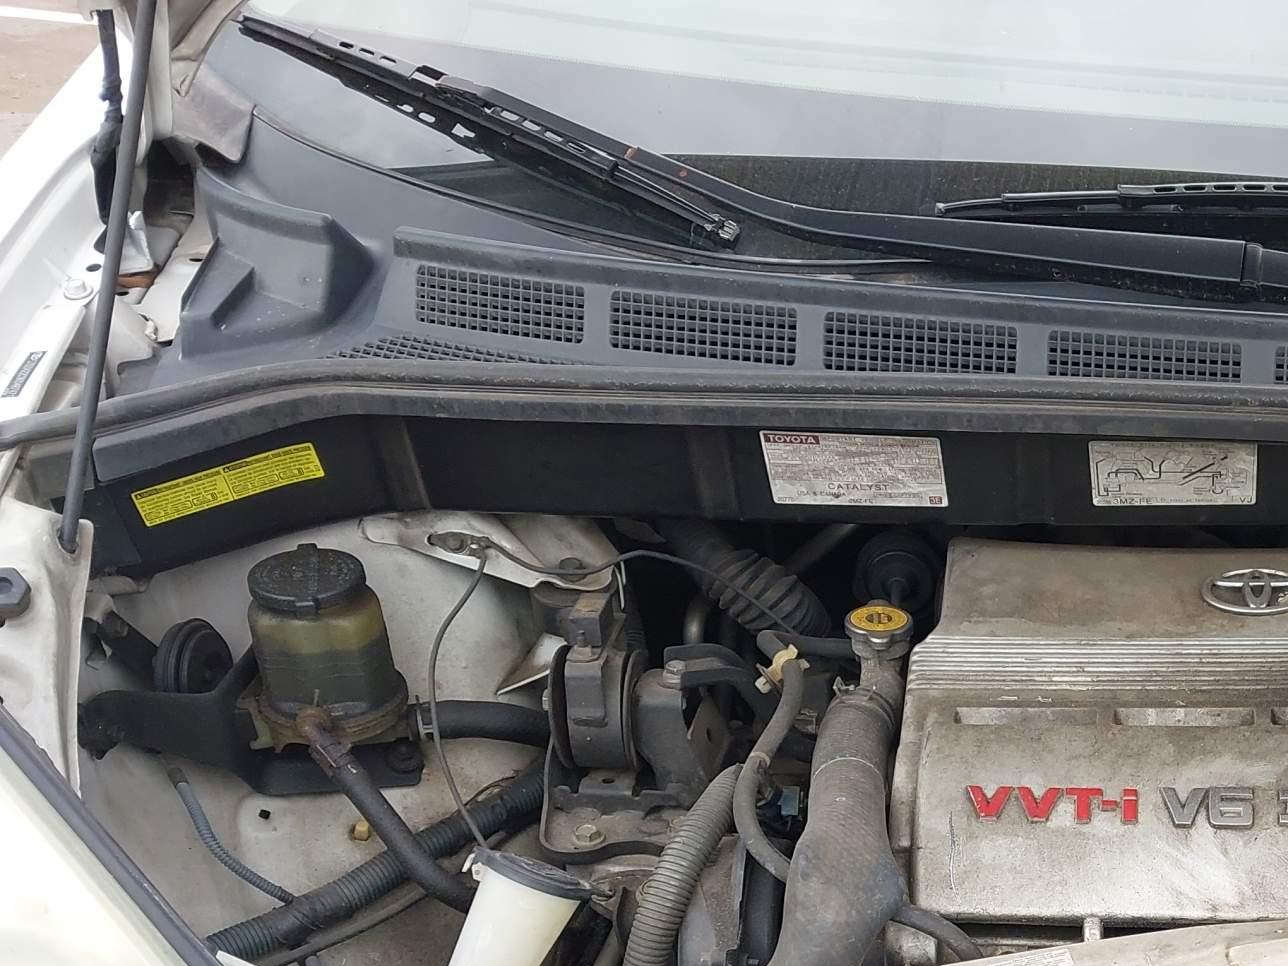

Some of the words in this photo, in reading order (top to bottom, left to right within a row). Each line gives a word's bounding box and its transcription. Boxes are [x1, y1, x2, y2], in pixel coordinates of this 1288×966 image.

[767, 434, 816, 444] TOYOTA
[827, 482, 889, 492] CATALYST
[966, 785, 1141, 824] VVT-i
[1159, 786, 1256, 830] V6
